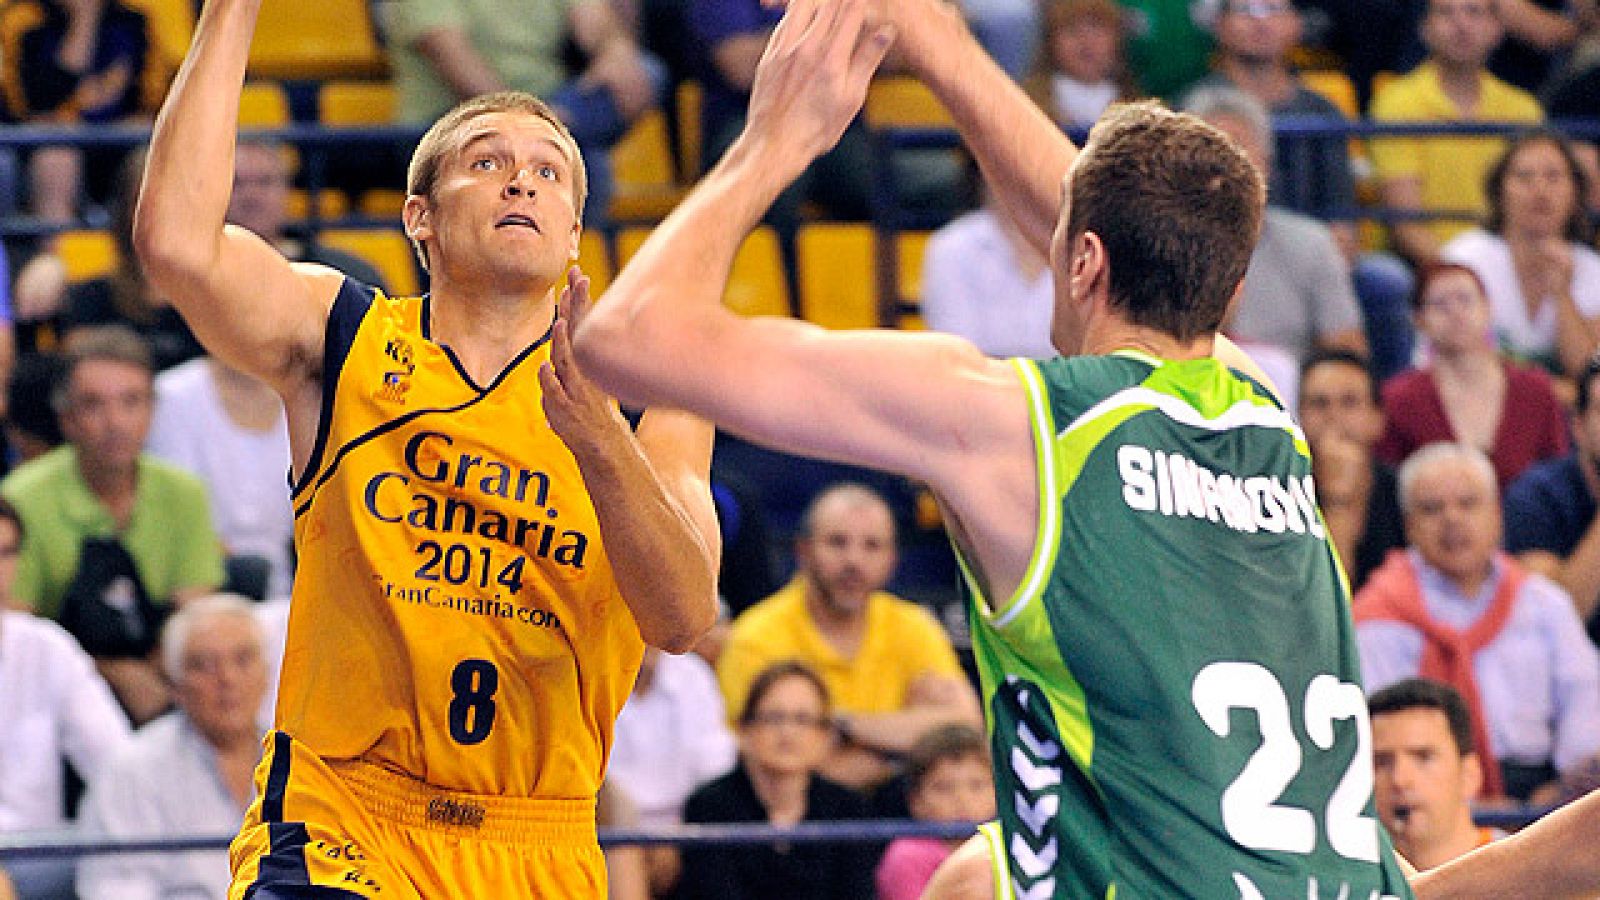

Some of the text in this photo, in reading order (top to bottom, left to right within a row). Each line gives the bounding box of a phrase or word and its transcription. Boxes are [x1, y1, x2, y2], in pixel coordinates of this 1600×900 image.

[404, 431, 551, 508] Gran
[364, 471, 589, 569] Canaria
[414, 540, 526, 595] 2014
[449, 659, 499, 746] 8
[1191, 661, 1380, 863] 22
